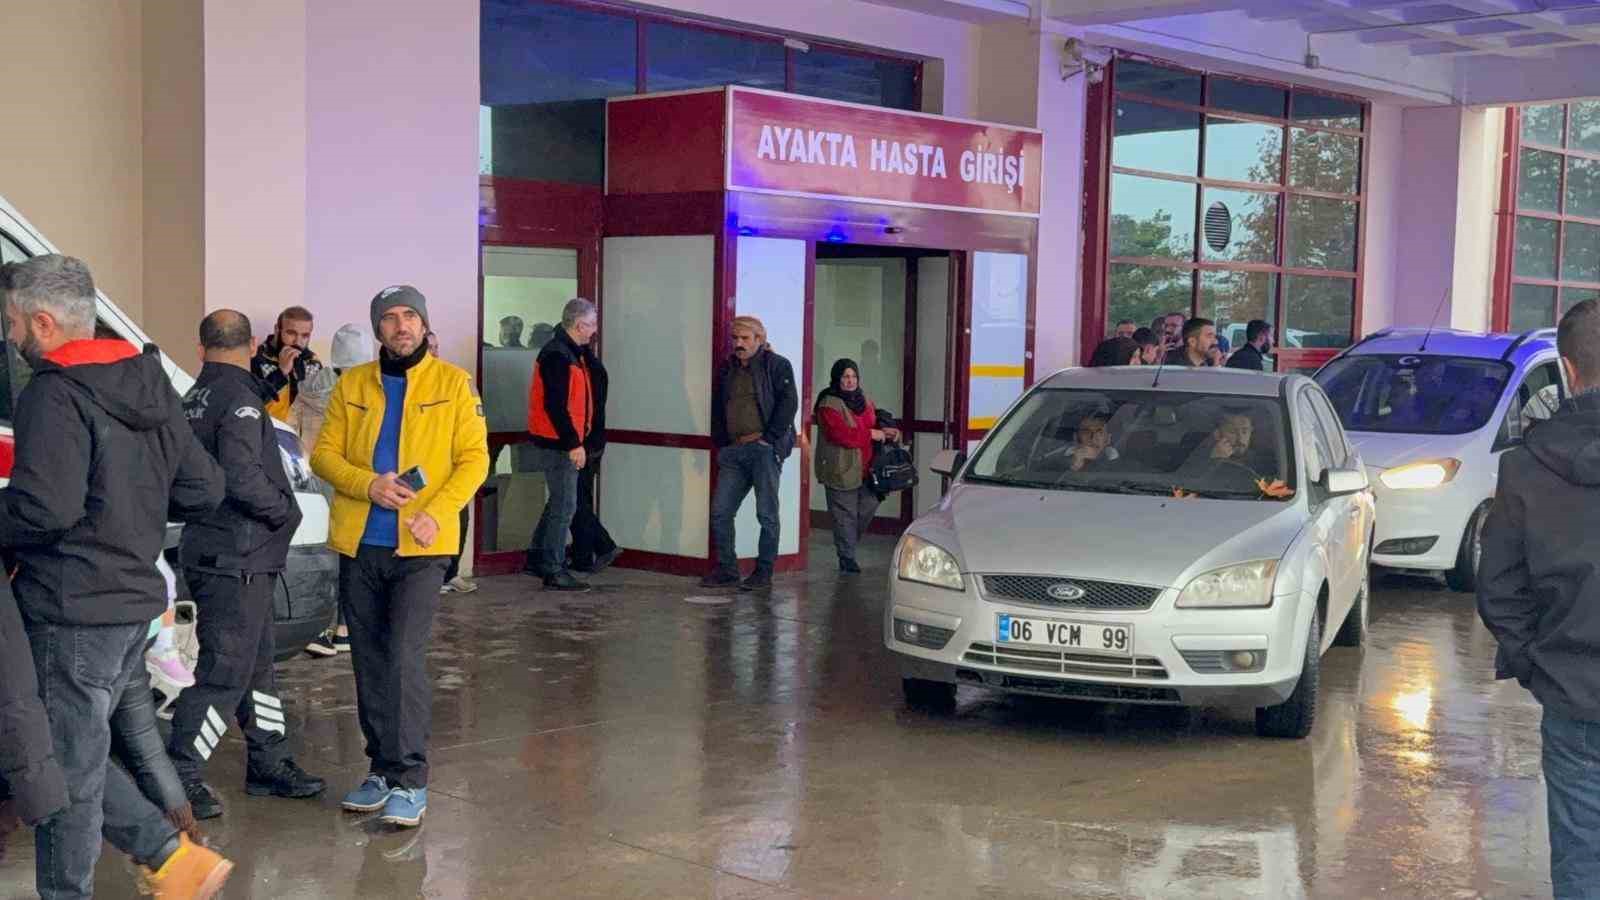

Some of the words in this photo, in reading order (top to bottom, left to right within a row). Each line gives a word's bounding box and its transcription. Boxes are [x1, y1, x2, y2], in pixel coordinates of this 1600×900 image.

[757, 125, 857, 168] AYAKTA
[870, 138, 947, 178] HASTA
[960, 144, 1025, 193] GİRİŞİ
[1011, 620, 1033, 641] 06
[1046, 623, 1082, 646] VCM
[1103, 628, 1127, 649] 99
